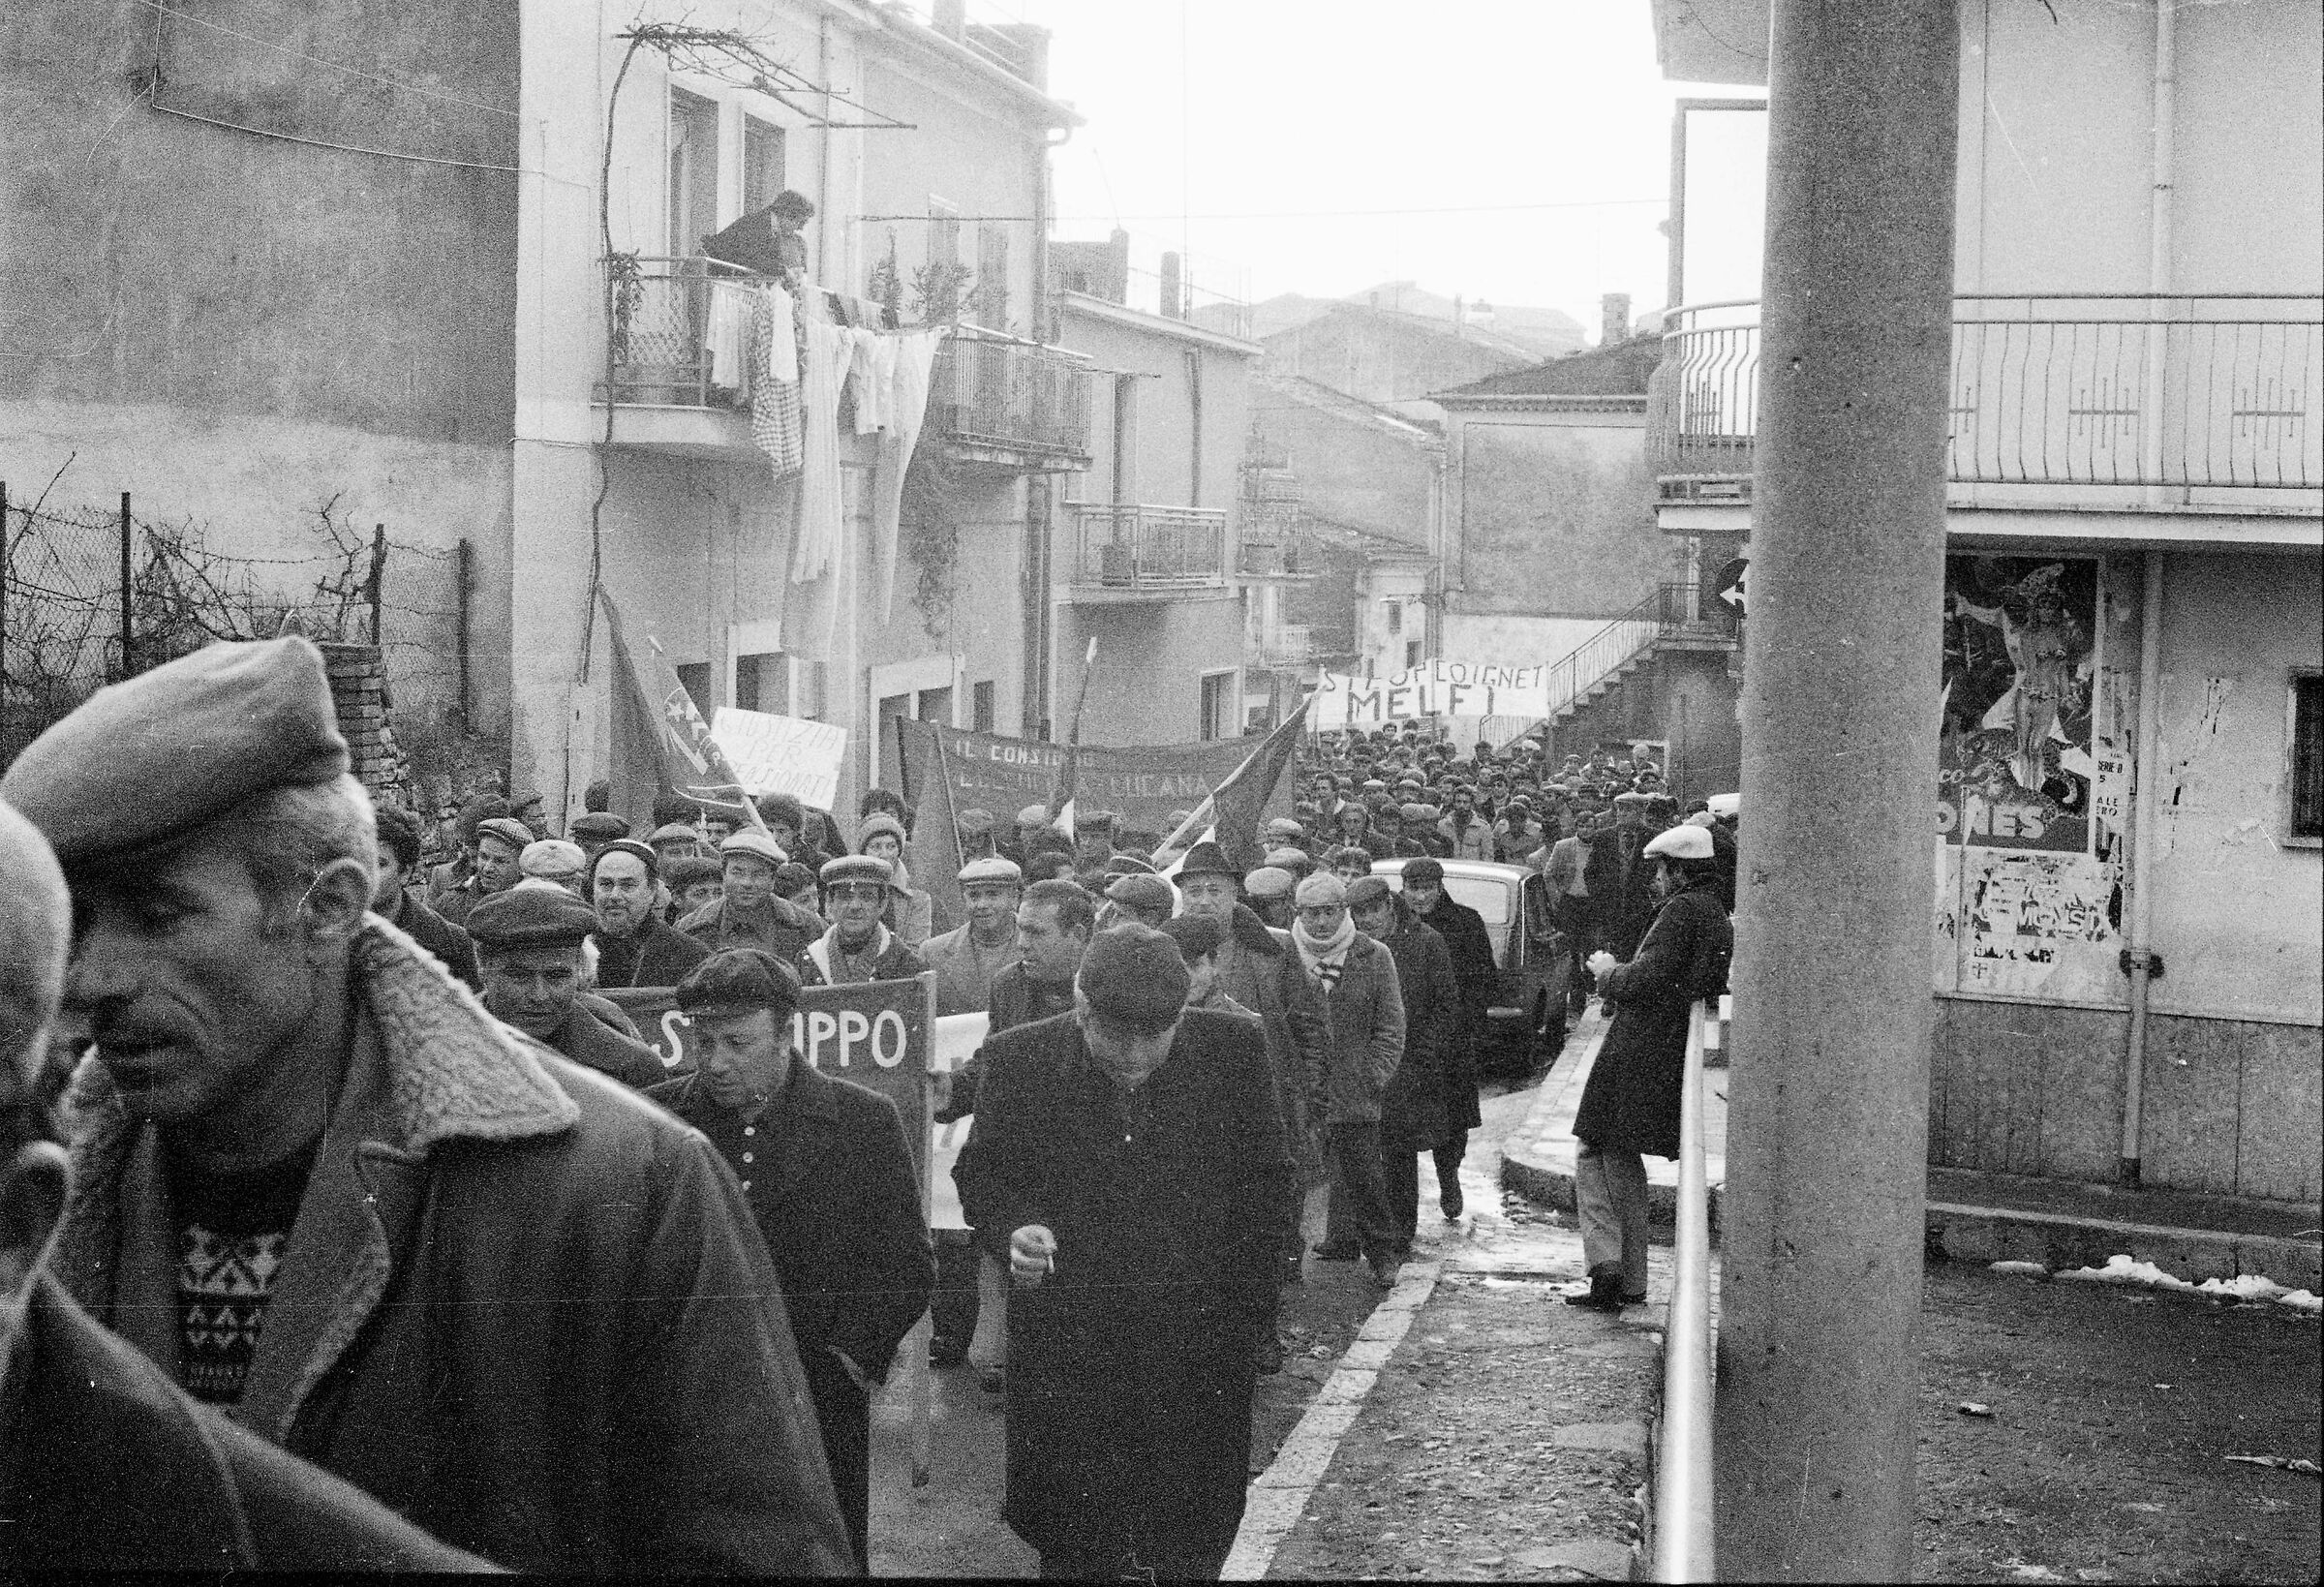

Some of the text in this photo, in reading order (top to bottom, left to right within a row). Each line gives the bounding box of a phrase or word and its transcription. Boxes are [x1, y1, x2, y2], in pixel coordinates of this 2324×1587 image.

[1346, 684, 1494, 723] MELFI
[719, 714, 840, 750] GIUSTIZIA
[747, 740, 802, 766] PER
[956, 739, 975, 757] IL
[1110, 773, 1210, 798] LUCANA
